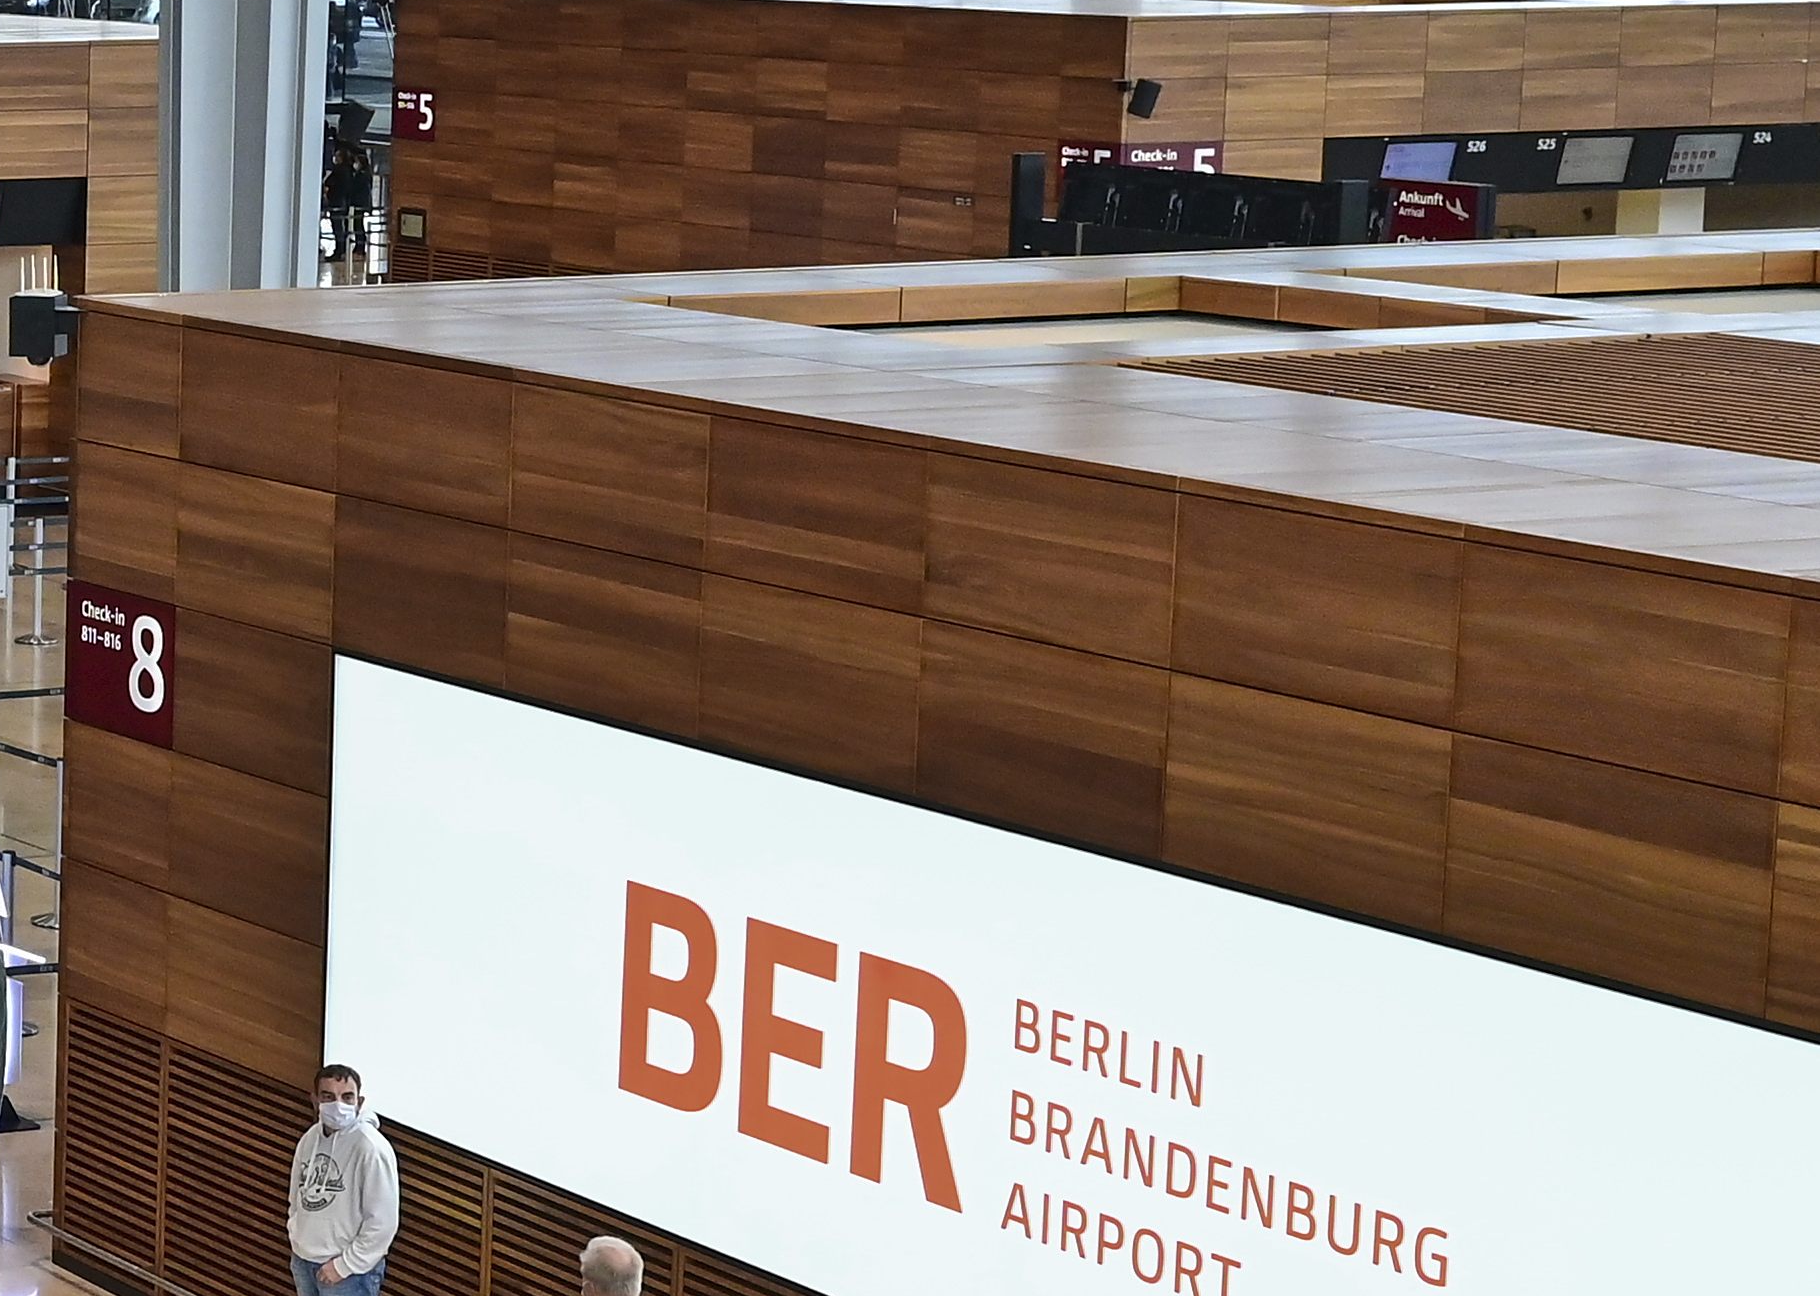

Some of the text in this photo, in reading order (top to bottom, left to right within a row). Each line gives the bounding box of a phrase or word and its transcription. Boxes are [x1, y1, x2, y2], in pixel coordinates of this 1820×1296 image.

[418, 93, 433, 130] 5
[1131, 149, 1178, 163] Check-in
[1398, 206, 1425, 217] Arrival
[1399, 190, 1443, 206] Ankunft
[82, 600, 125, 626] Check-in
[129, 615, 164, 713] 8
[617, 879, 1205, 1215] BER BERLIN
[1009, 1089, 1450, 1289] BRANDENBURG
